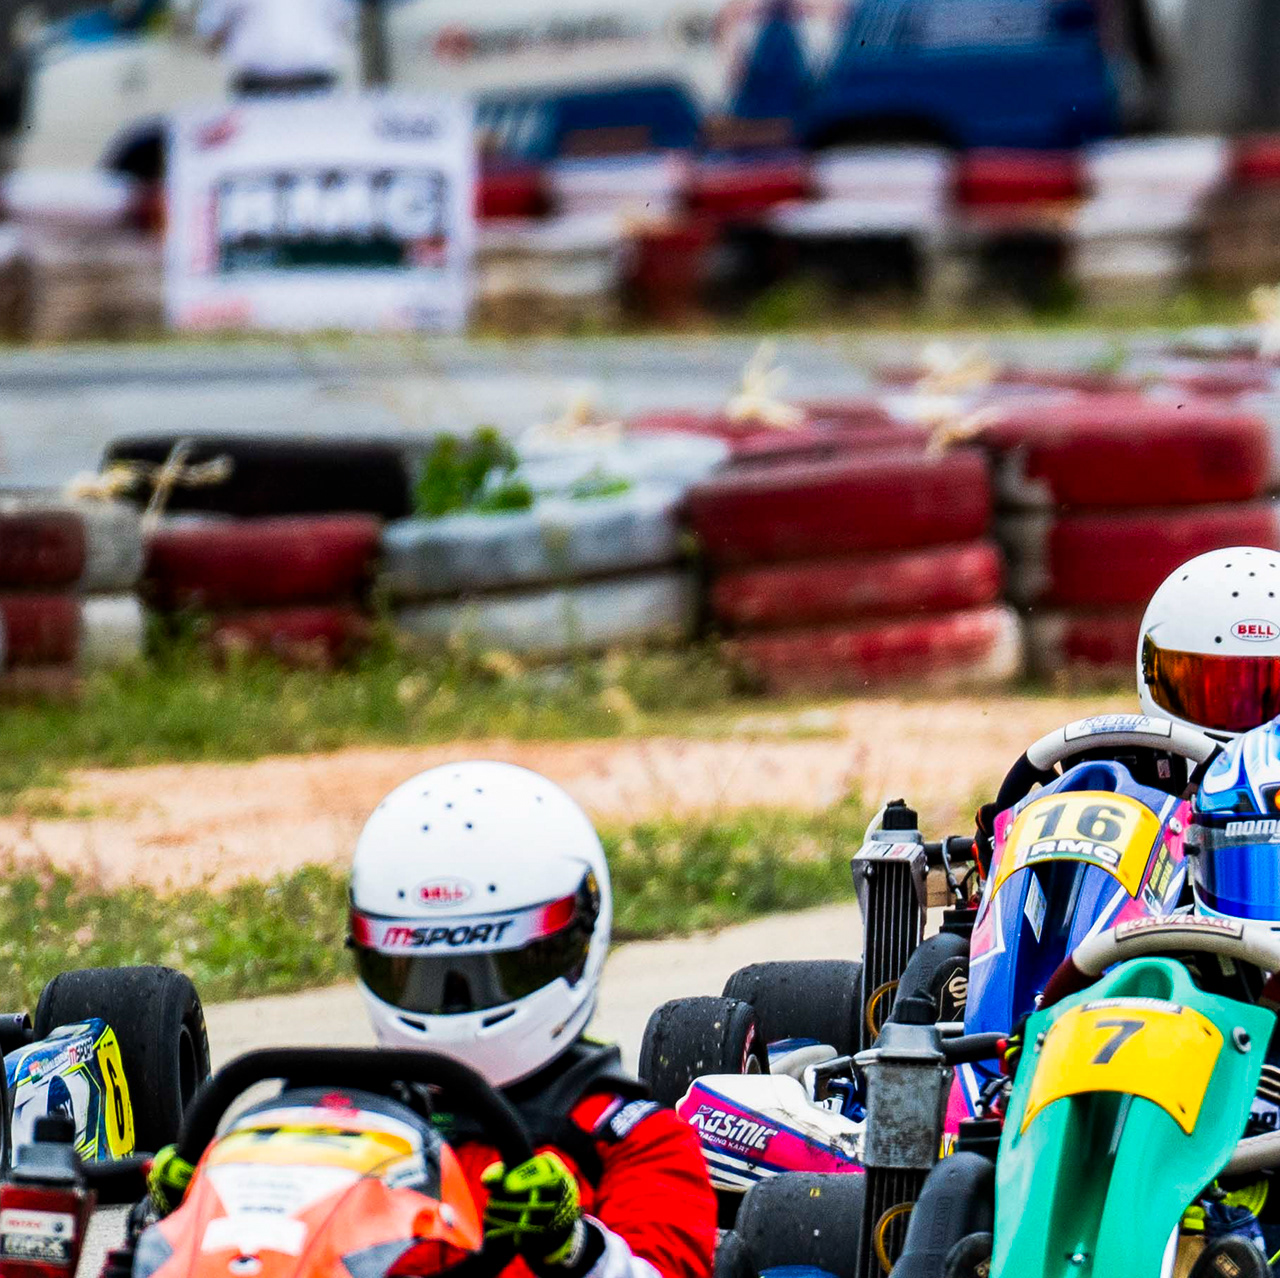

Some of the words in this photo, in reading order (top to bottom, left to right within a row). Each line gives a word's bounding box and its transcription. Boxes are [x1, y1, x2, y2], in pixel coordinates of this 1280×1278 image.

[1238, 624, 1274, 636] BELL
[1035, 803, 1127, 842] 16
[1031, 839, 1120, 866] RMC
[1093, 1020, 1145, 1065] 7
[689, 1104, 779, 1150] KOSMIC
